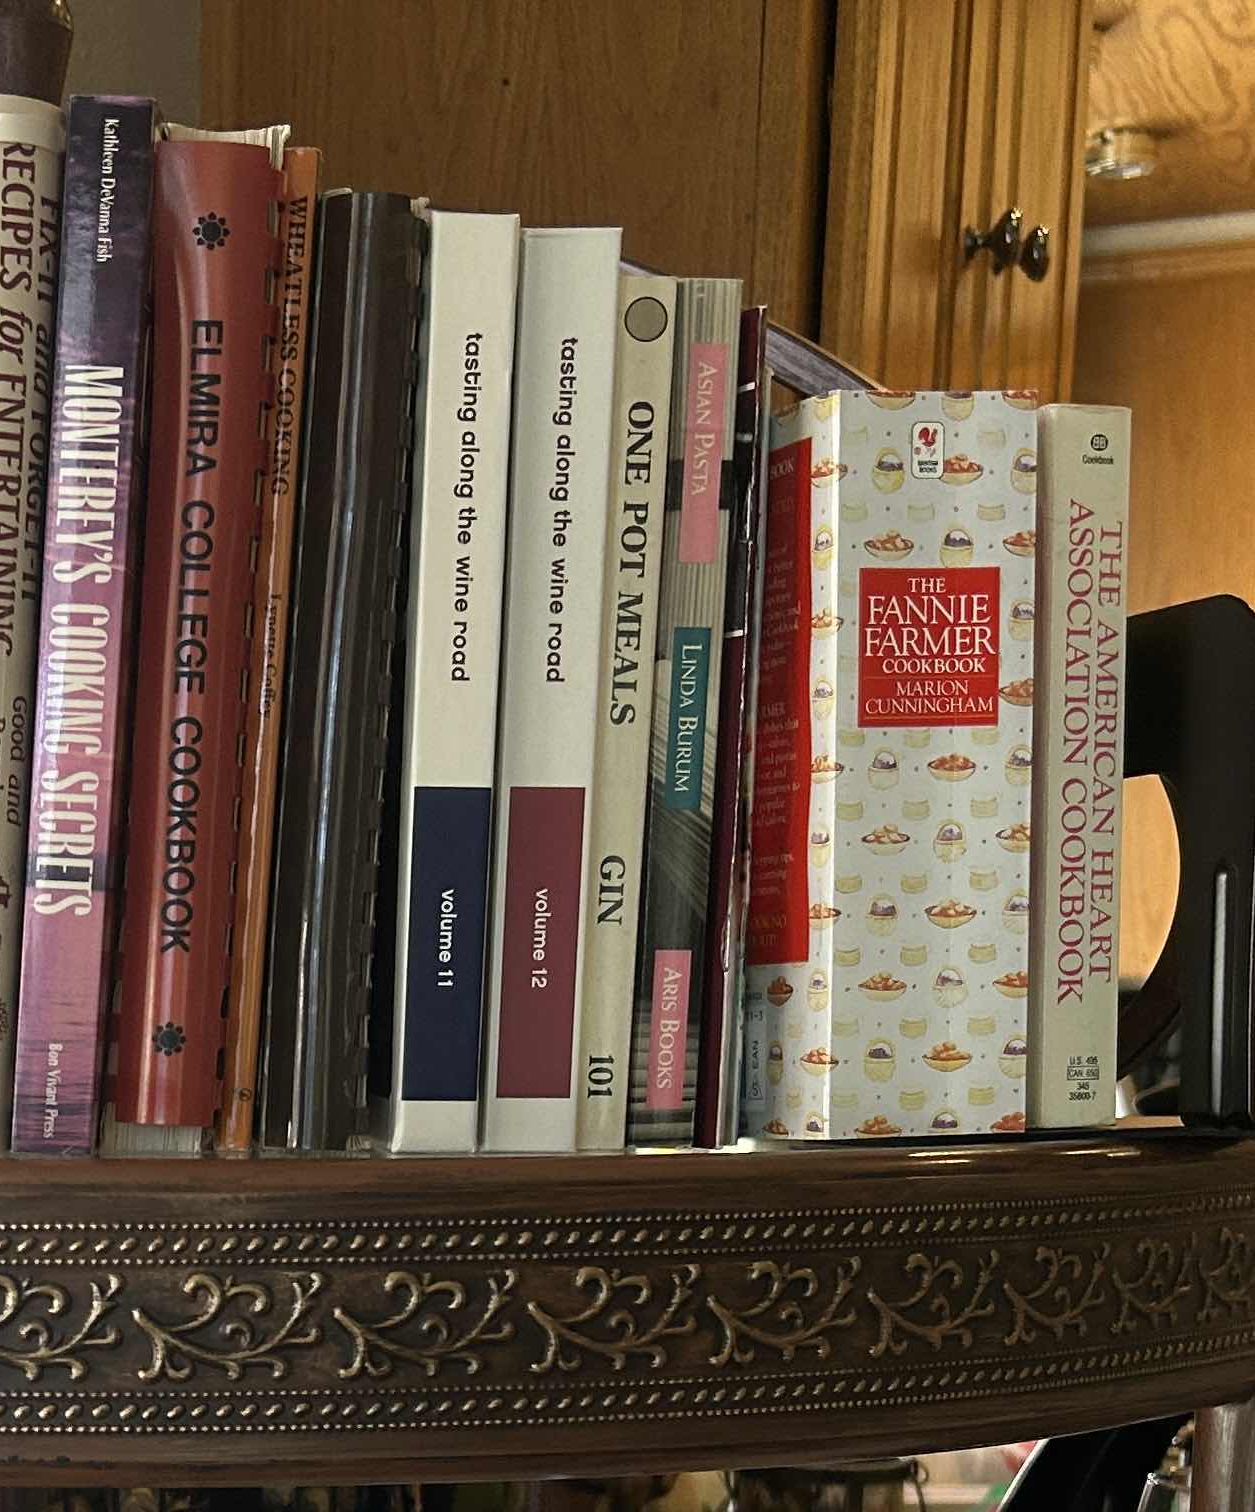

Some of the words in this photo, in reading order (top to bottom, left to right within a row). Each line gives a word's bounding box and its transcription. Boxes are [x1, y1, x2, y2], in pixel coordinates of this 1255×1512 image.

[101, 119, 120, 174] Kathleen
[99, 177, 118, 225] DeVanna
[96, 230, 114, 263] Fish
[184, 320, 223, 477] ELMIRA
[456, 332, 484, 423] tasting
[697, 361, 720, 427] ASIAN
[52, 366, 124, 585] MONTEREY'S
[454, 432, 481, 499] along
[624, 401, 655, 486] ONE
[690, 433, 715, 497] PASTA
[457, 507, 479, 546] the
[619, 502, 650, 578] POT
[172, 500, 215, 695] COLLEGE
[454, 555, 470, 613] wine
[908, 577, 946, 594] THE
[1097, 521, 1124, 608] THE
[864, 626, 996, 657] FARMER
[867, 595, 992, 626] FANNIE
[1062, 498, 1095, 765] ASSOCIATION
[44, 603, 111, 756] COOKING
[450, 621, 471, 682] road
[608, 592, 644, 727] MEALS
[678, 644, 703, 709] LINDA
[882, 657, 987, 674] COOKBOOK
[865, 697, 994, 715] CUNNINGHAM
[896, 679, 969, 697] MARION
[673, 716, 699, 793] BURUM
[1091, 622, 1121, 836] AMERICAN
[33, 770, 100, 917] SECRETS
[160, 717, 203, 954] COOKBOOK
[596, 855, 626, 926] GIN
[1056, 778, 1088, 1005] COOKBOOK
[1088, 848, 1116, 982] HEART
[437, 889, 458, 963] volume
[530, 889, 552, 962] volume
[437, 969, 454, 988] 11
[530, 968, 548, 990] 12
[587, 1055, 615, 1099] 101
